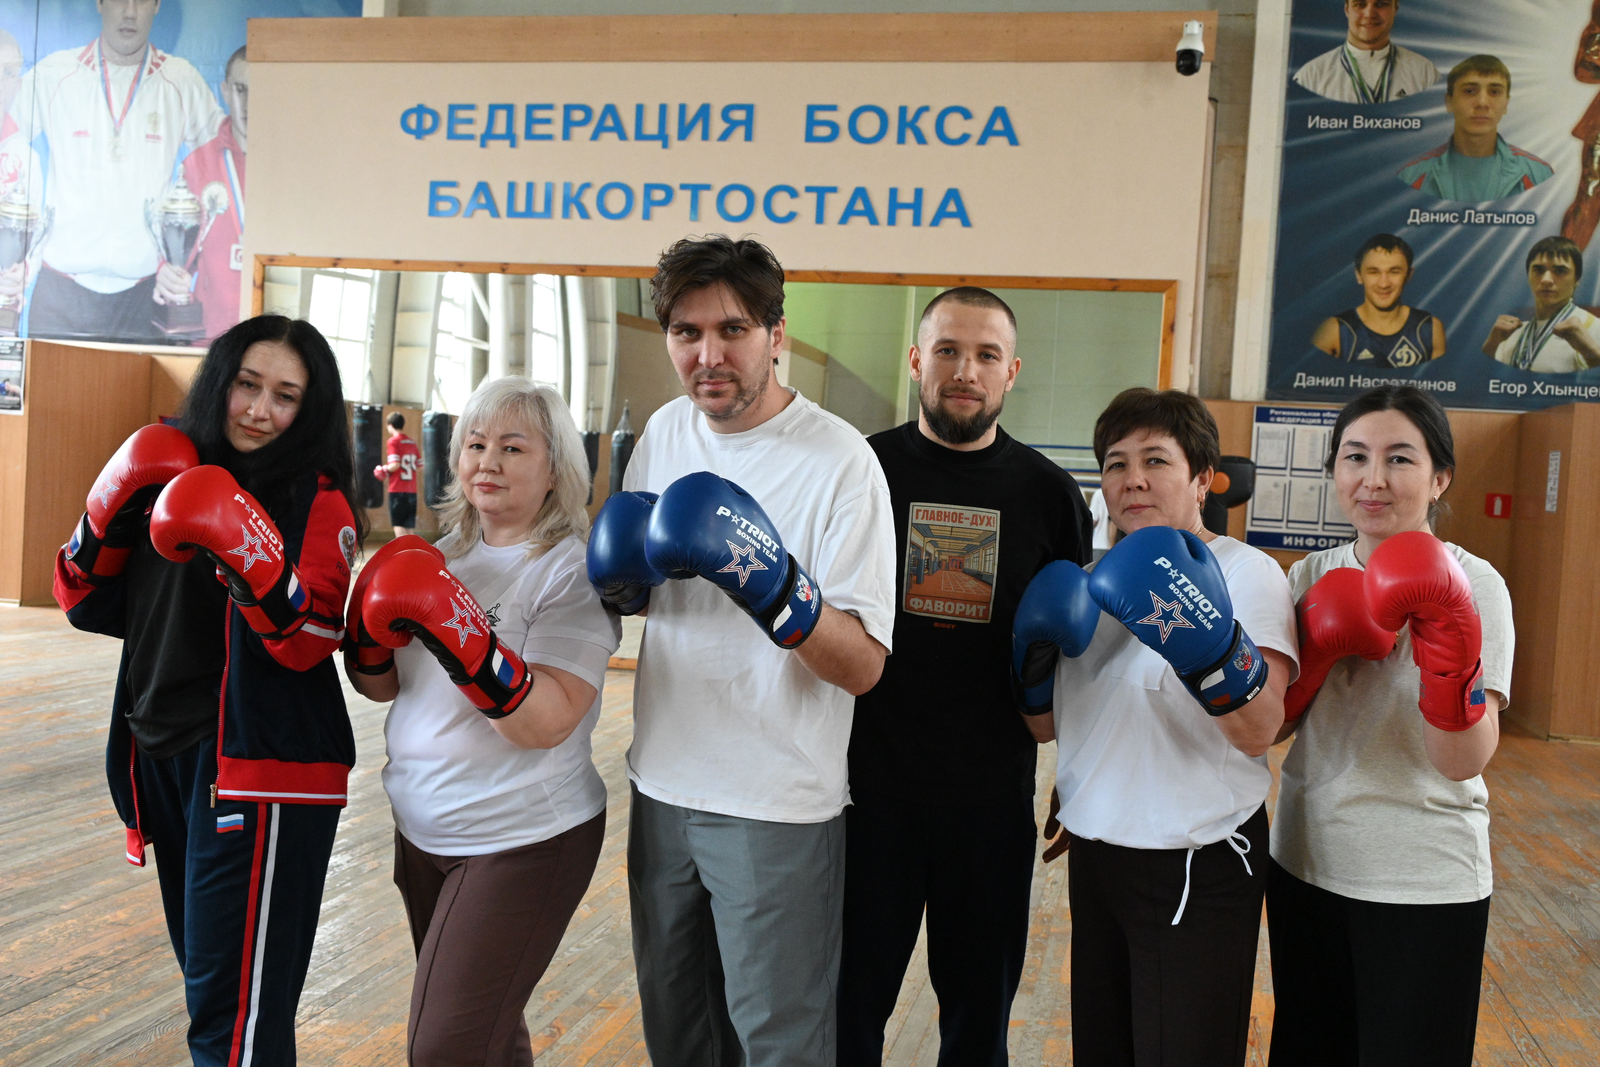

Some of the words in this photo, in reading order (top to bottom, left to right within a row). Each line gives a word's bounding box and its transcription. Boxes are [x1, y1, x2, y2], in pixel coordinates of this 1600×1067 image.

[400, 103, 755, 149] ФЕДЕРАЦИЯ
[804, 104, 1020, 146] БОКСА
[1307, 114, 1348, 129] Иван
[1353, 115, 1421, 130] Виханов
[427, 180, 973, 228] БАШКОРТОСТАНА
[1407, 208, 1459, 225] Данис
[1463, 209, 1536, 225] Латыпов
[1293, 372, 1345, 389] Данил
[1488, 380, 1527, 398] Егор
[248, 518, 268, 544] BOXING
[268, 542, 282, 562] TEAM
[736, 528, 761, 550] BOXING
[762, 546, 778, 564] TEAM
[1283, 536, 1350, 548] ИНФОРМ
[335, 561, 348, 577] RU
[456, 592, 476, 618] BOXING
[909, 597, 987, 618] ФАВОРИТ
[1168, 583, 1195, 611] BOXING
[1195, 610, 1214, 631] TEAM
